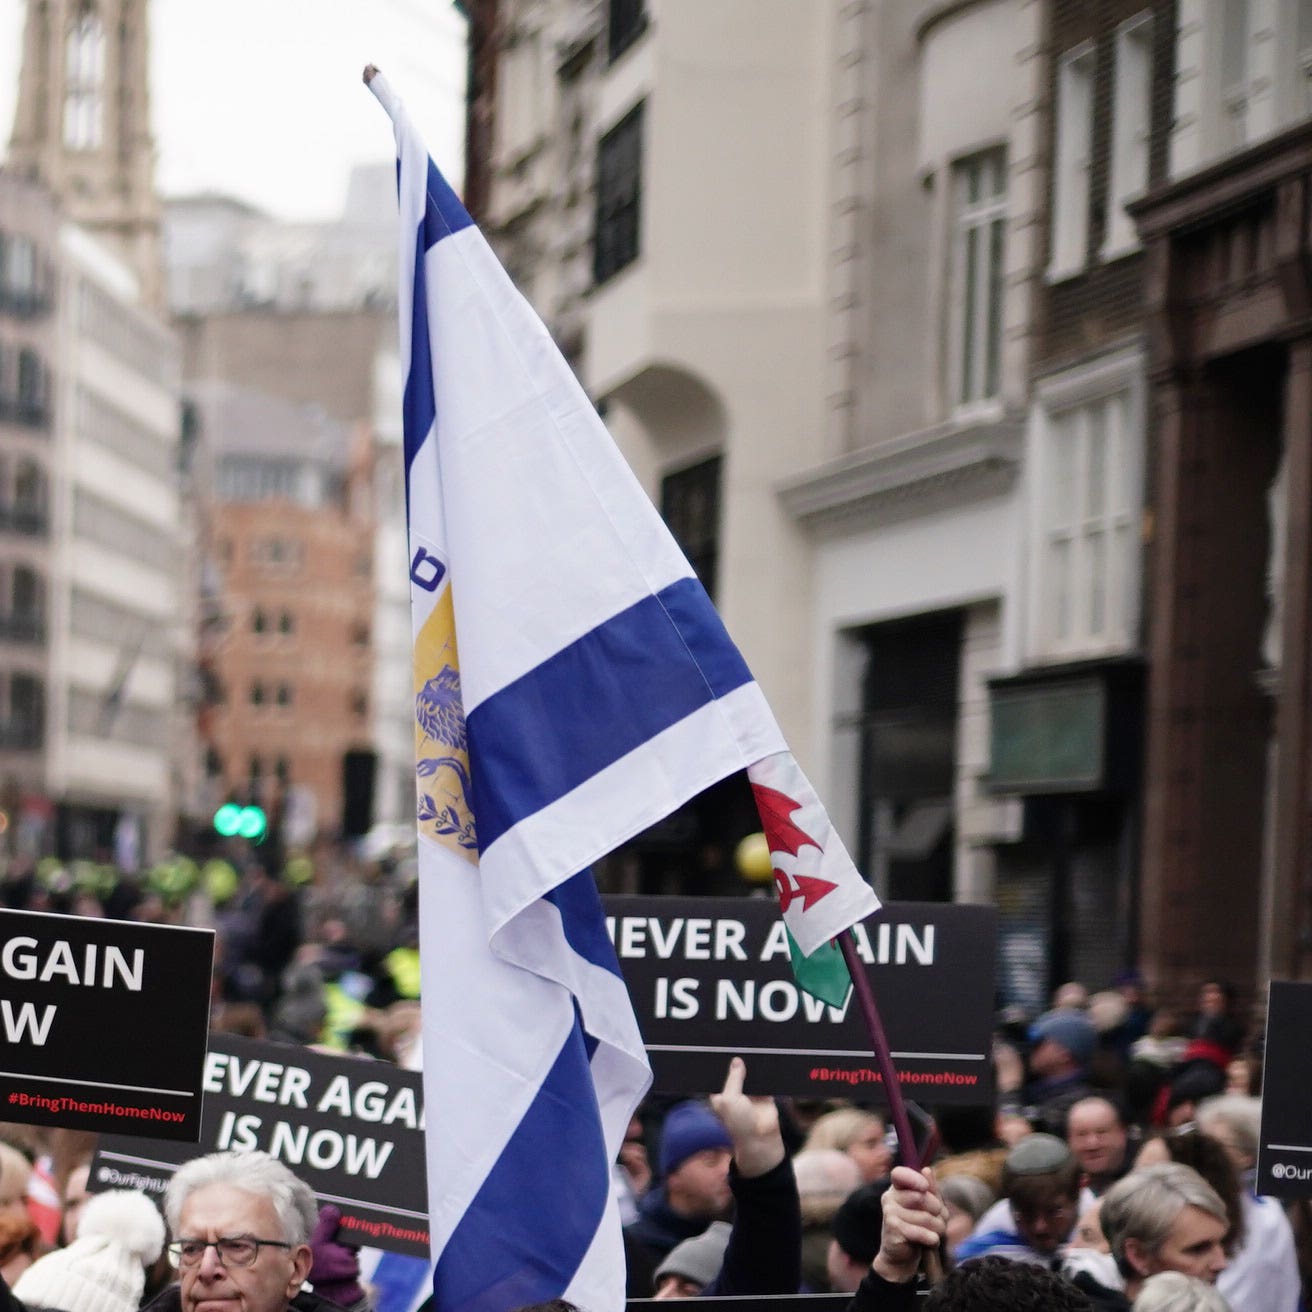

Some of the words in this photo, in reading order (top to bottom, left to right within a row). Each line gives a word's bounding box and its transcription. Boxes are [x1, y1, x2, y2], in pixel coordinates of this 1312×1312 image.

[760, 923, 935, 966] AAIN
[654, 976, 699, 1020] IS
[716, 979, 854, 1024] NOW
[203, 1052, 312, 1109] EVER
[317, 1074, 426, 1131] AGA
[809, 1068, 978, 1086] #BringTheHomeNow
[8, 1092, 186, 1123] #BringThemHomeNow
[217, 1110, 263, 1152] IS
[270, 1120, 394, 1180] NOW
